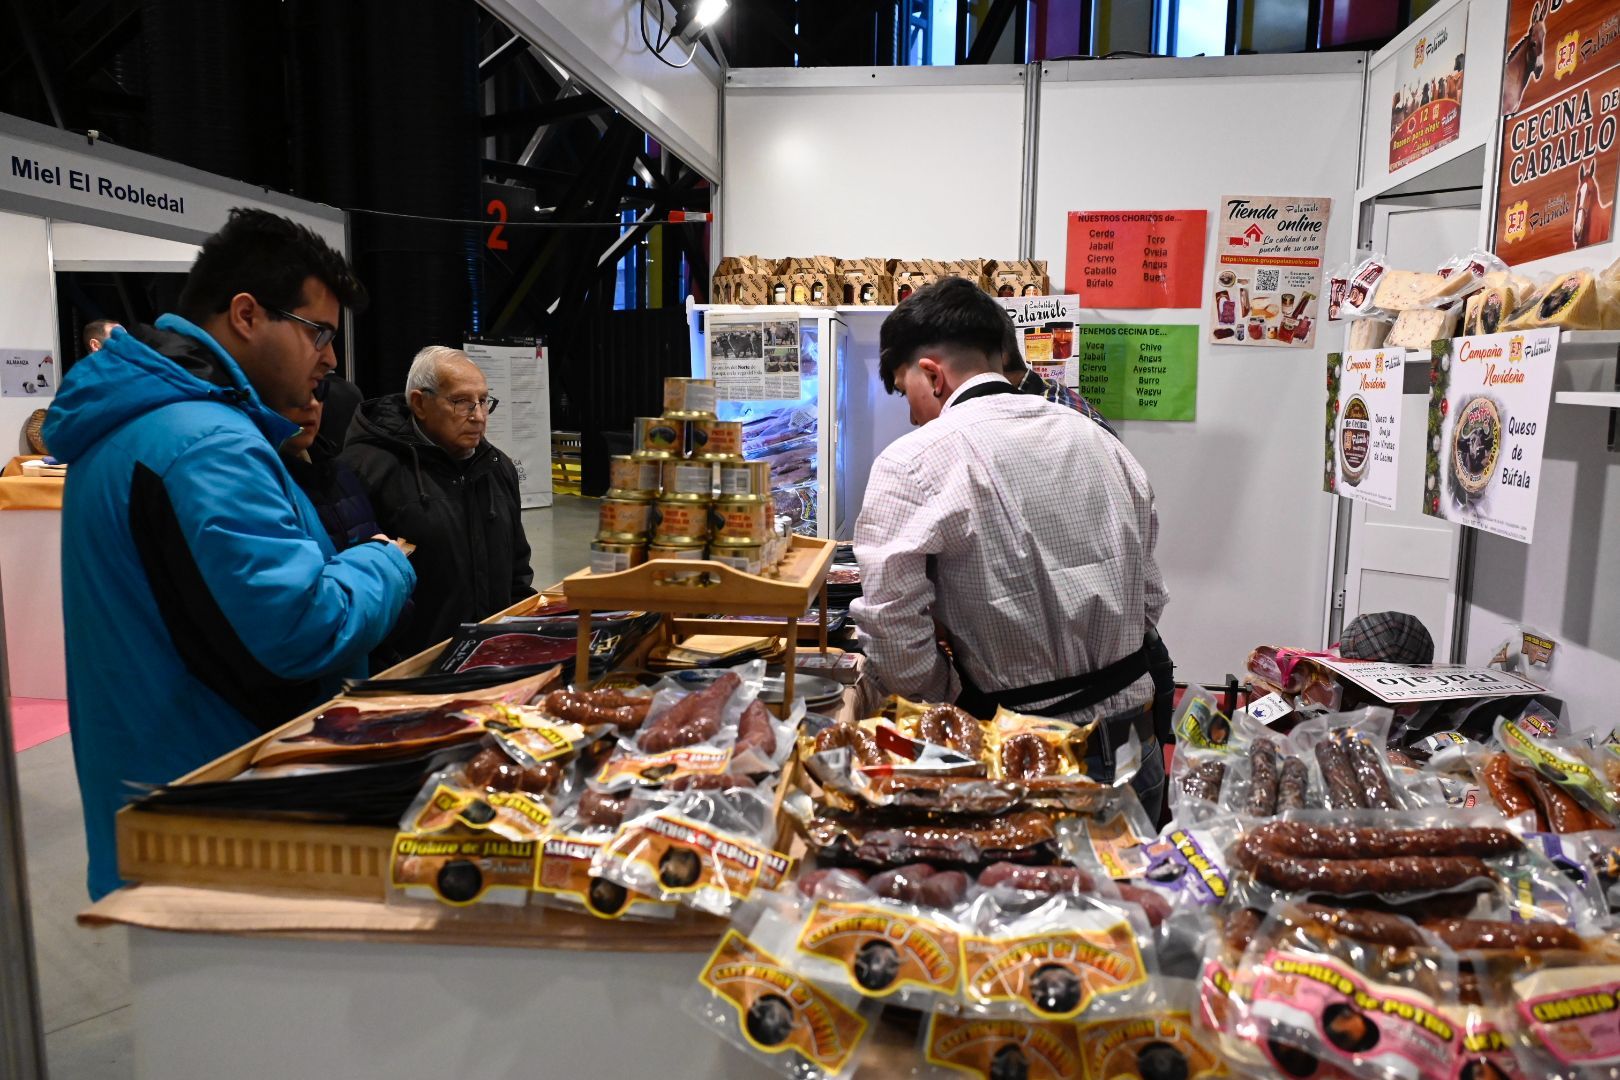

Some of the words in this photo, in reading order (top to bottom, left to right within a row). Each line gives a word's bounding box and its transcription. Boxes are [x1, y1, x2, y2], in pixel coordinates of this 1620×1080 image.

[1511, 90, 1593, 152] CECINA
[1601, 88, 1619, 113] DE
[1510, 117, 1616, 185] CABALLO
[12, 156, 60, 185] Miel
[69, 170, 90, 192] El
[98, 177, 184, 213] Robledal
[1228, 199, 1278, 220] Tienda
[1078, 214, 1120, 222] NUESTROS
[1122, 214, 1163, 222] CHORIZOS
[487, 200, 508, 250] 2
[1277, 214, 1322, 232] online
[1089, 230, 1115, 238] Cerdo
[1147, 235, 1165, 244] Toro
[1263, 235, 1273, 245] La
[1276, 234, 1300, 244] calidad
[1089, 241, 1114, 250] Jabalí
[1259, 246, 1280, 254] puerta
[1144, 247, 1168, 257] Oveja
[1087, 254, 1115, 263] Ciervo
[1142, 260, 1168, 270] Angus
[1084, 266, 1117, 275] Caballo
[1086, 278, 1113, 288] Búfalo
[1080, 327, 1116, 336] TENEMOS
[1117, 327, 1148, 336] CECINA
[1086, 342, 1105, 350] Vaca
[1140, 343, 1162, 352] Chivo
[1084, 352, 1106, 361] Jabalí
[1459, 340, 1503, 364] Campaña
[1138, 355, 1162, 363] Angus
[1082, 363, 1107, 372] Ciervo
[1133, 366, 1167, 374] Avestruz
[1483, 363, 1525, 386] Navideña
[1138, 376, 1160, 384] Burro
[1136, 387, 1162, 396] Wagyu
[1085, 396, 1101, 404] Toro
[1138, 399, 1158, 407] Buey
[1508, 416, 1537, 436] Queso
[1511, 445, 1523, 461] de
[1501, 467, 1531, 489] Búfala
[1376, 672, 1500, 689] Búfalo
[1384, 690, 1405, 698] de
[1409, 684, 1532, 696] Hamburguesa
